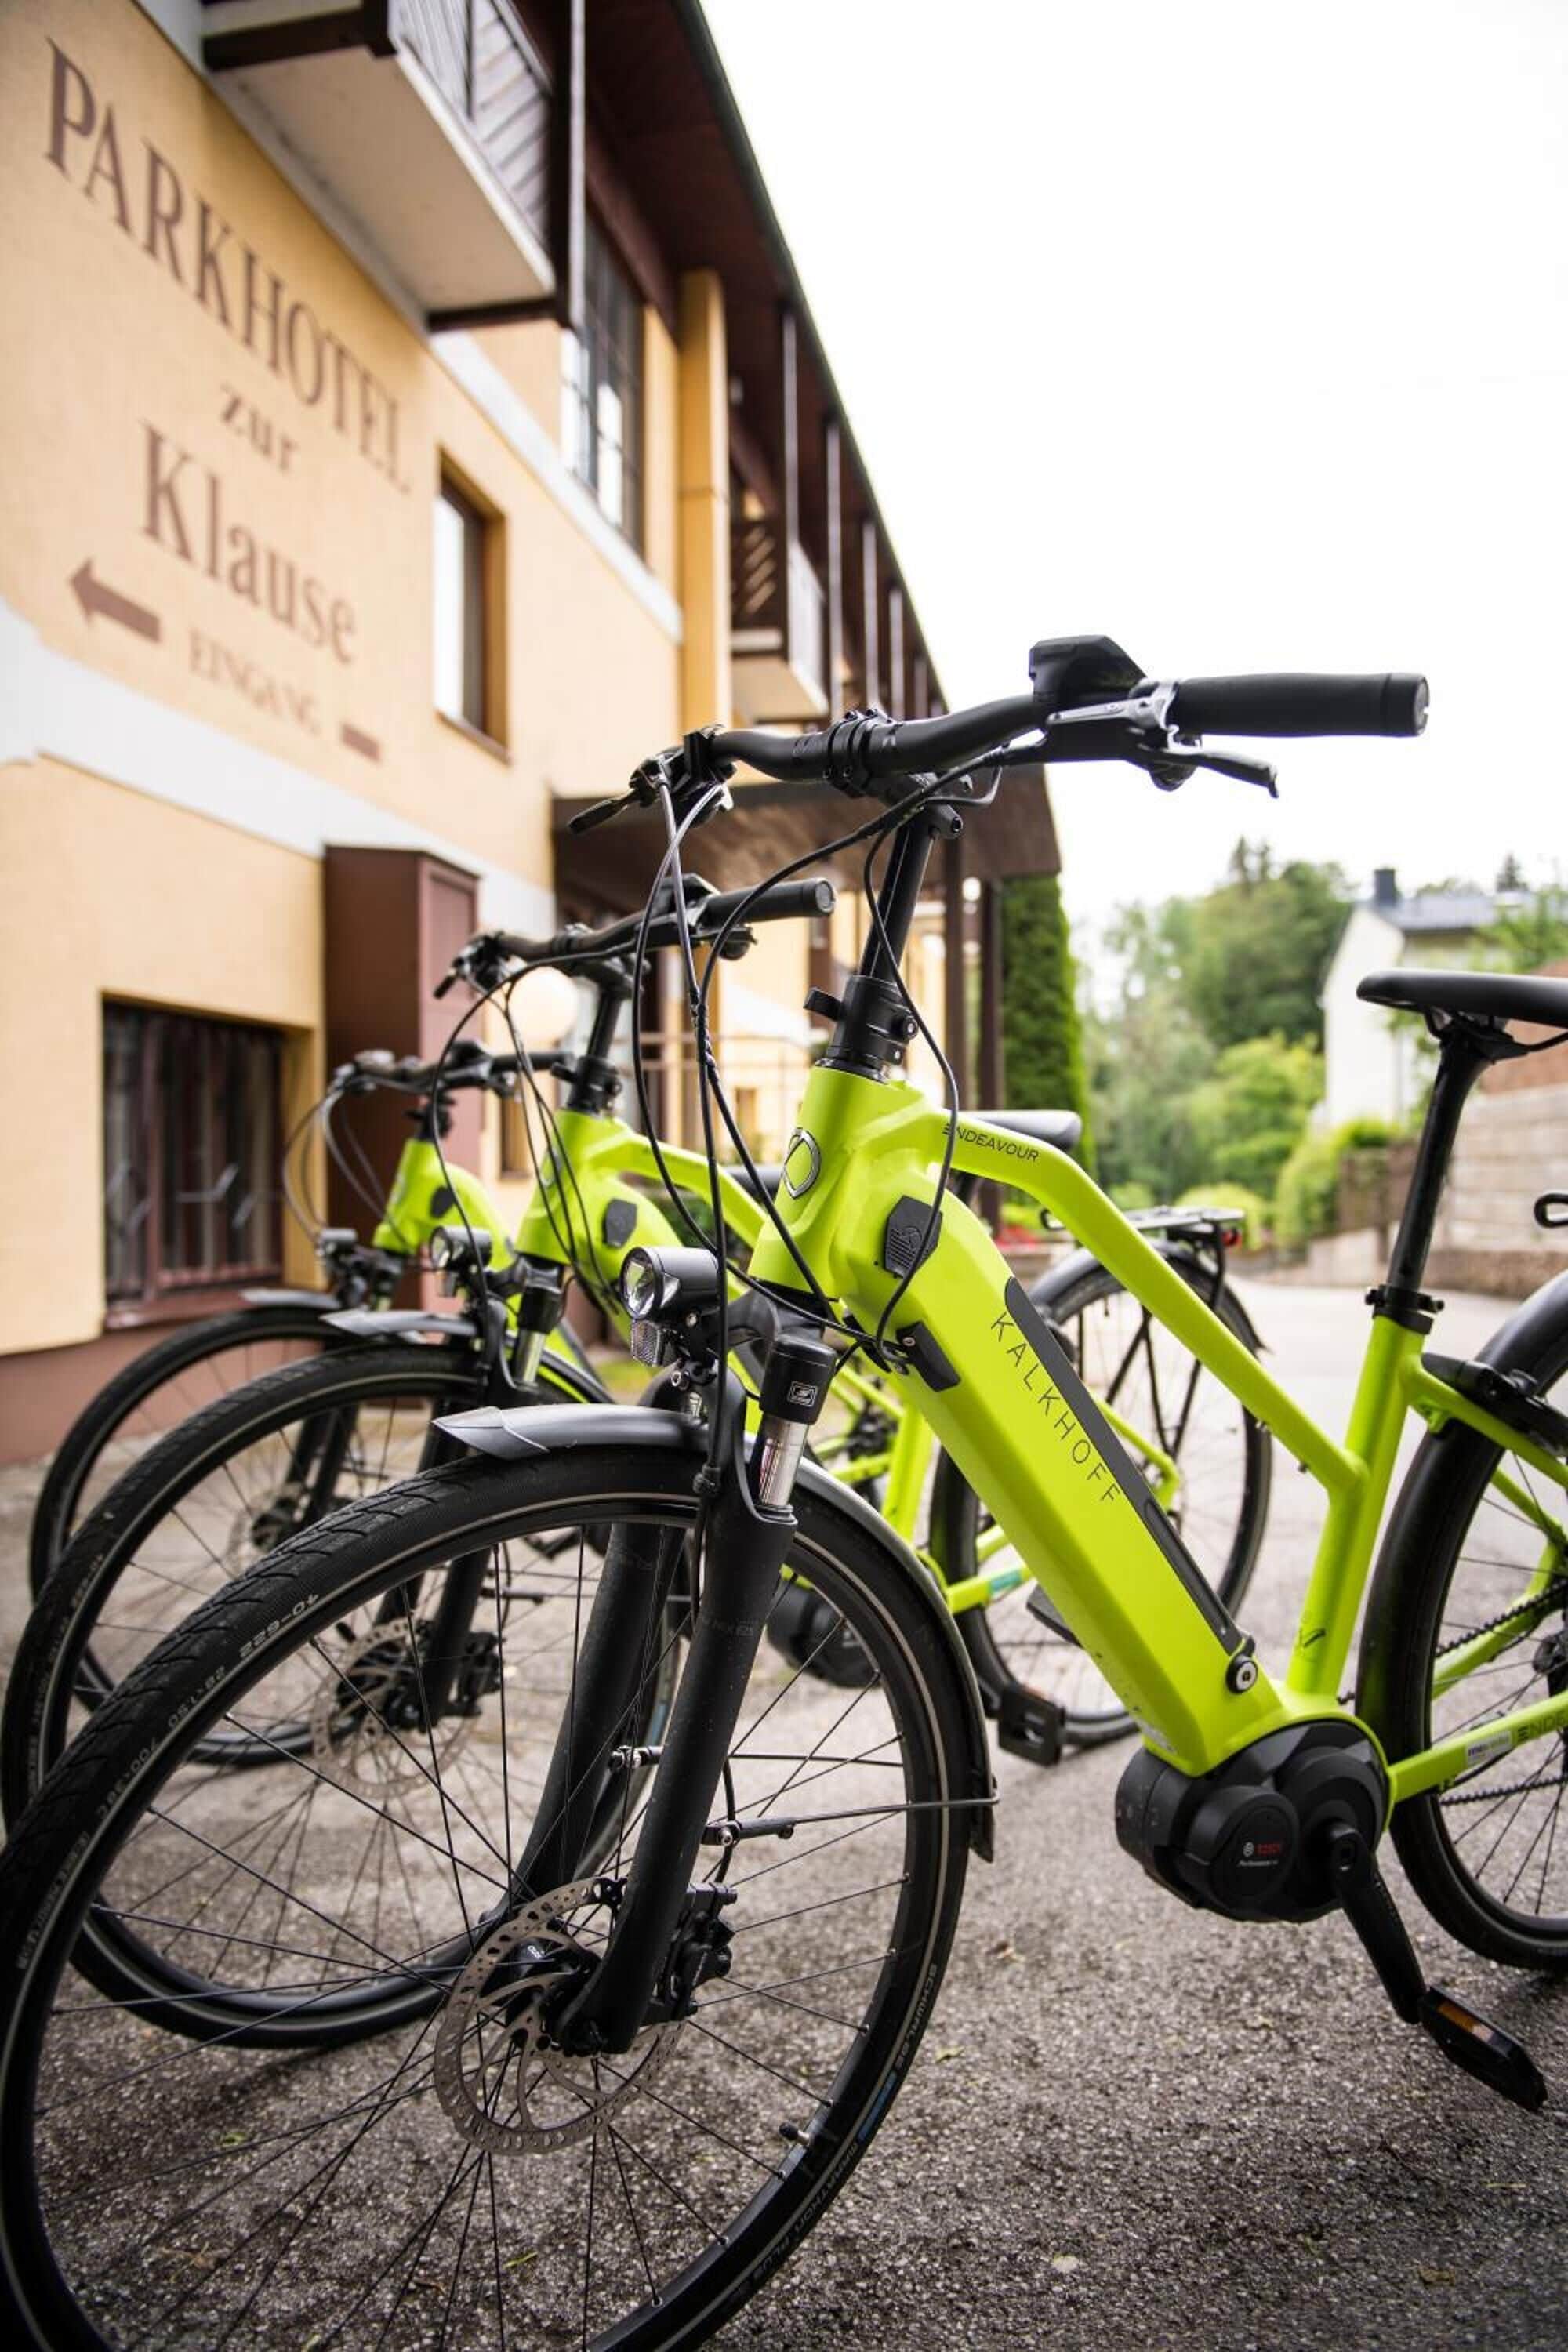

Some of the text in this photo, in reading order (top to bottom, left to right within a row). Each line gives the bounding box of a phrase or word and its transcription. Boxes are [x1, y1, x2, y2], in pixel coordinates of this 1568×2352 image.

[43, 37, 412, 497] PARKHOTEL
[220, 384, 299, 472] zur
[139, 420, 357, 665] Klause
[188, 629, 321, 735] EINGANG
[990, 1311, 1122, 1503] KALKHOFF
